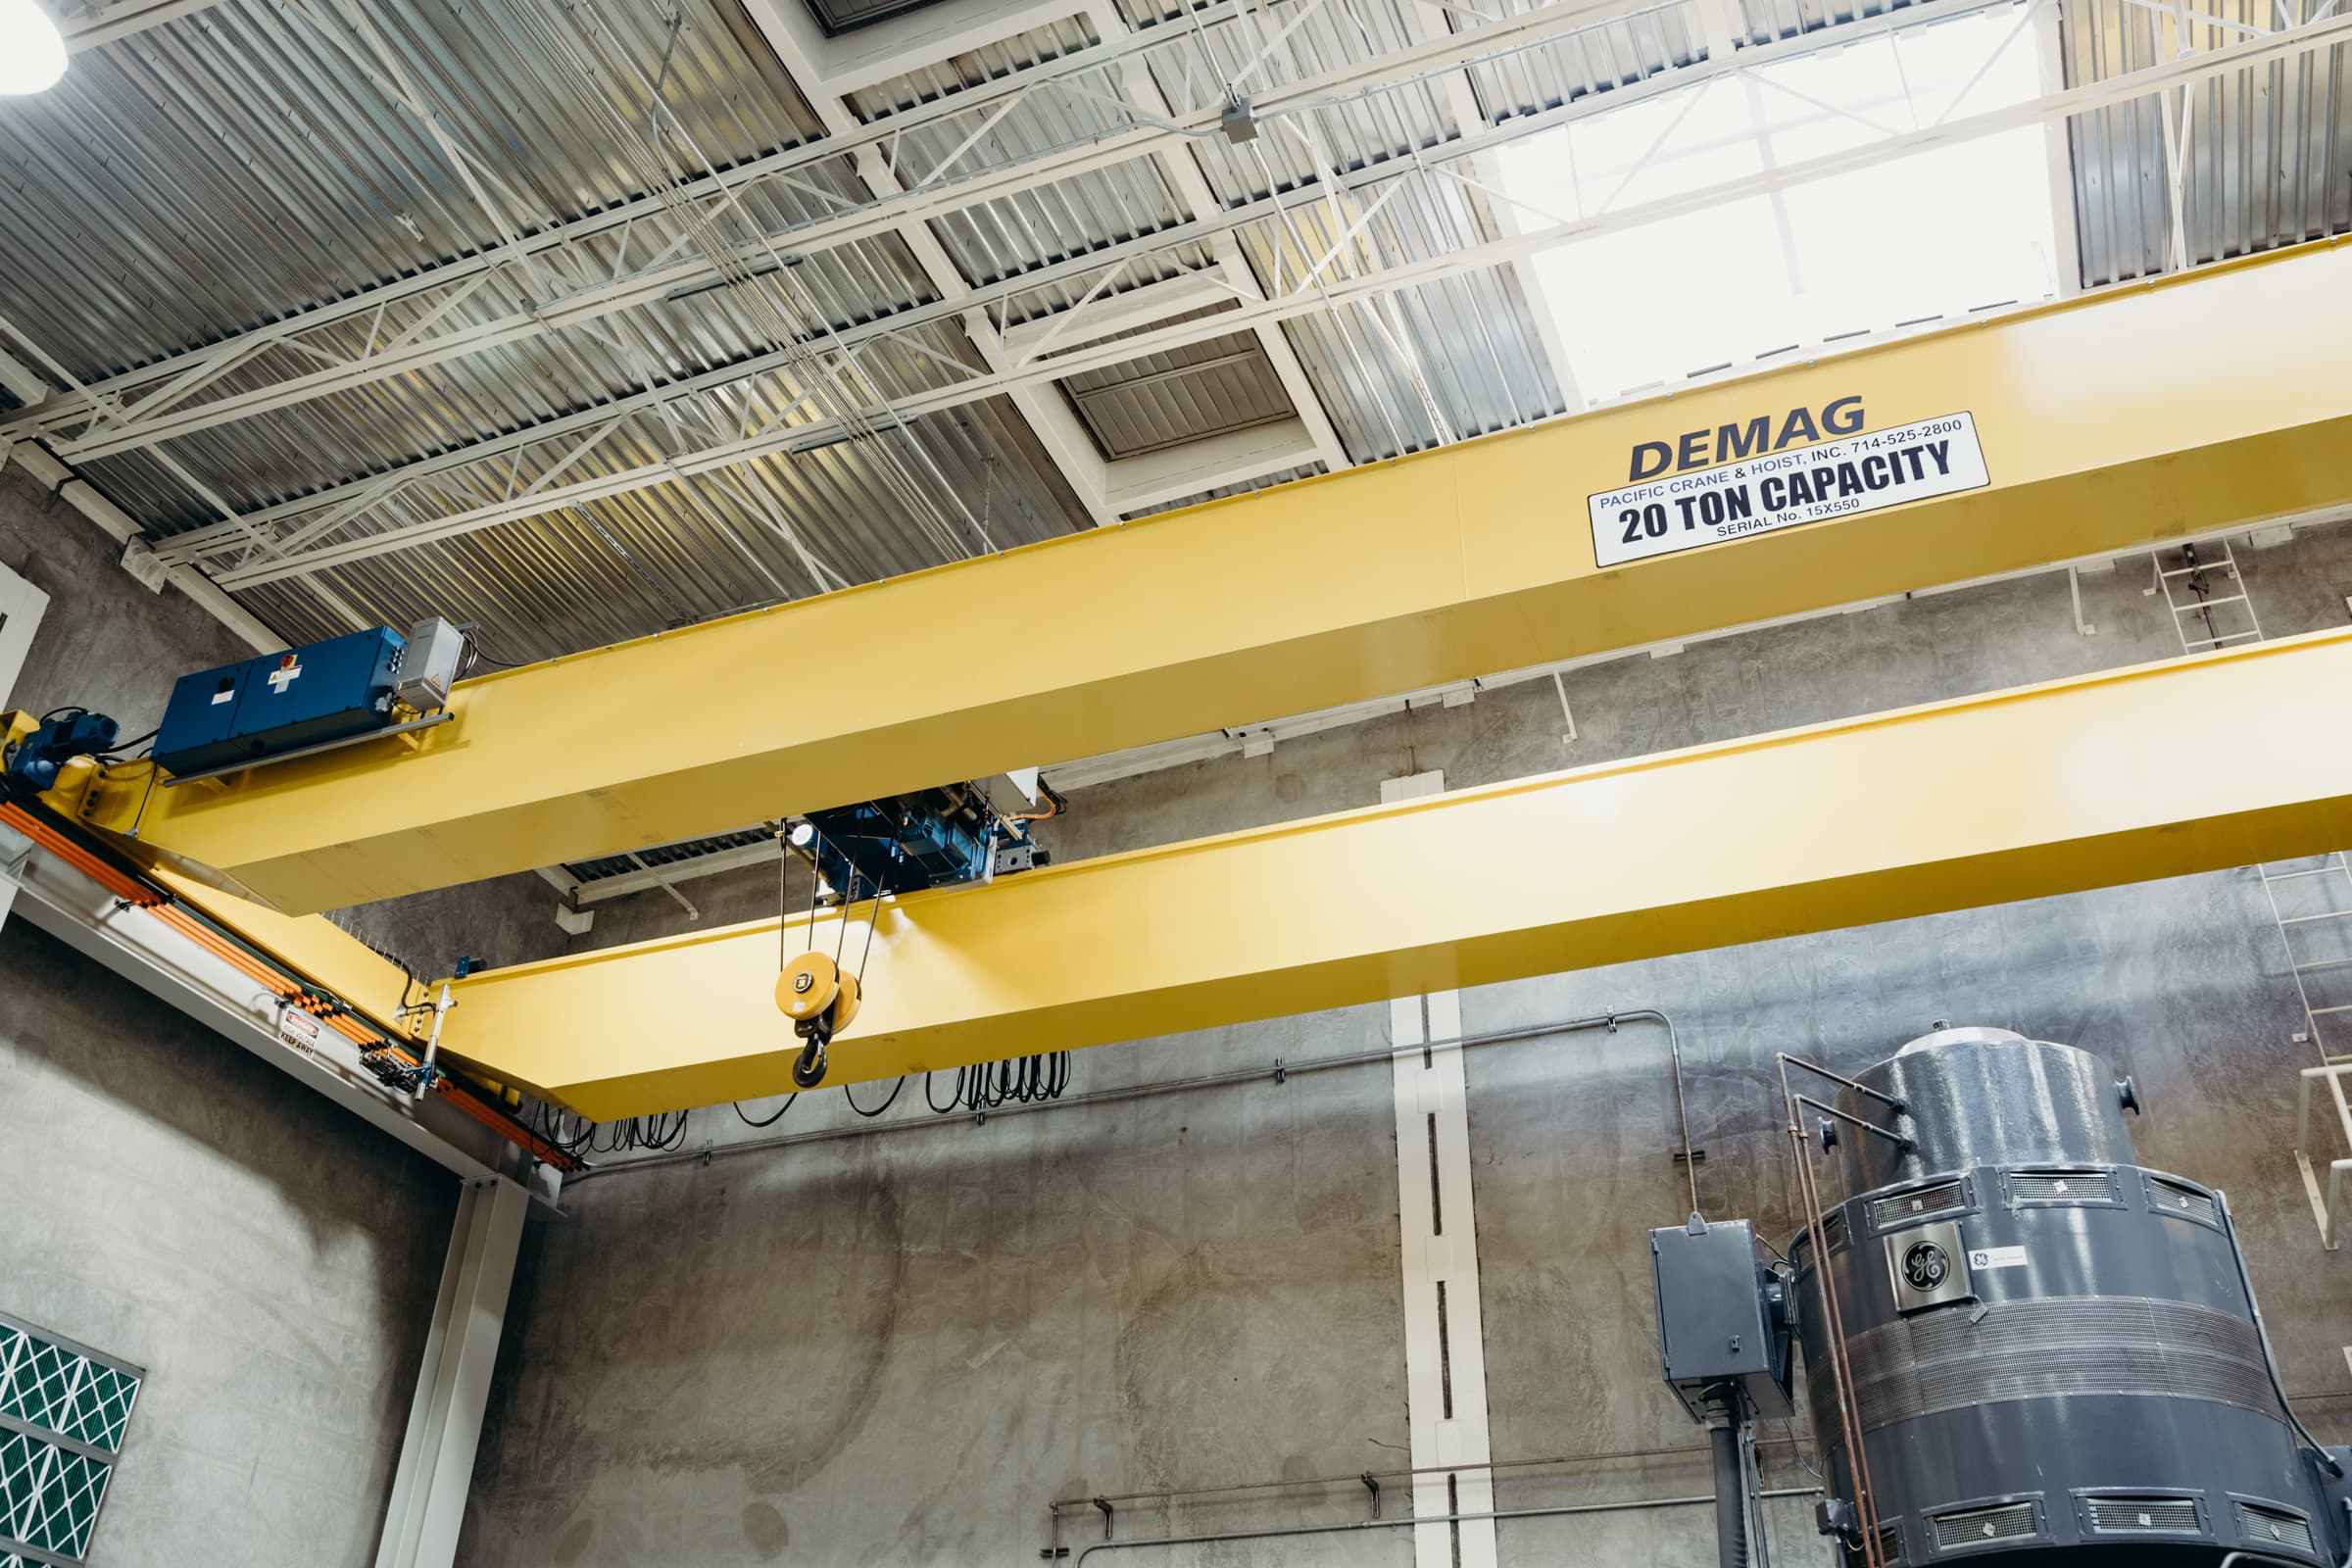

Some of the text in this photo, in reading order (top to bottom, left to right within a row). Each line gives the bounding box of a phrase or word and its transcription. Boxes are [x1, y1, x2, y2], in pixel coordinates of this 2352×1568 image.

[1600, 418, 1963, 509] PACIFIC CRANE & HOIST, INC. 714-525-2800
[1629, 395, 1865, 482] DEMAG
[1619, 439, 1950, 544] 20 TON CAPACITY
[1716, 498, 1860, 537] SERIAL No. 15X550
[280, 1031, 314, 1055] KEEP AWAY
